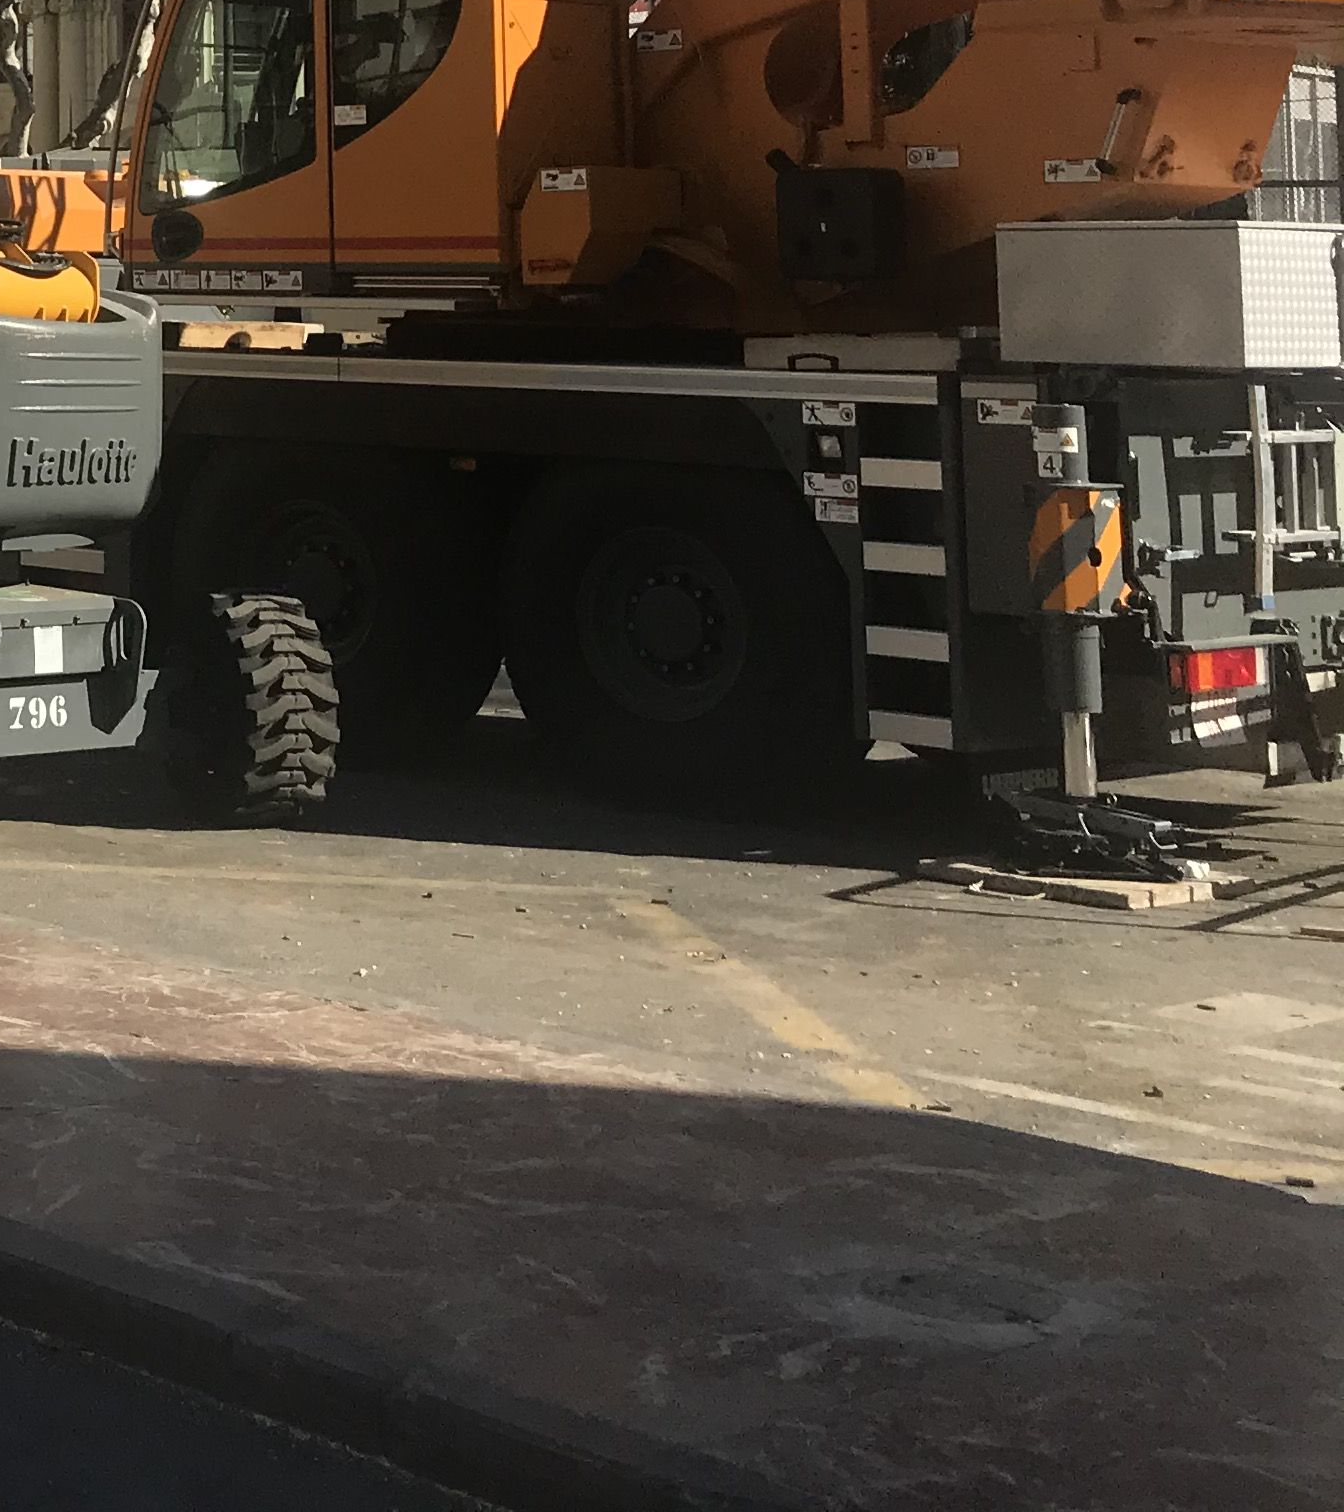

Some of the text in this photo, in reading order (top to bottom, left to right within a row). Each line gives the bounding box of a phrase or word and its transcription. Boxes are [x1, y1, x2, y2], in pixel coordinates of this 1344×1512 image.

[6, 436, 137, 487] Haulotte
[1043, 455, 1056, 474] 4
[9, 694, 68, 729] 796
